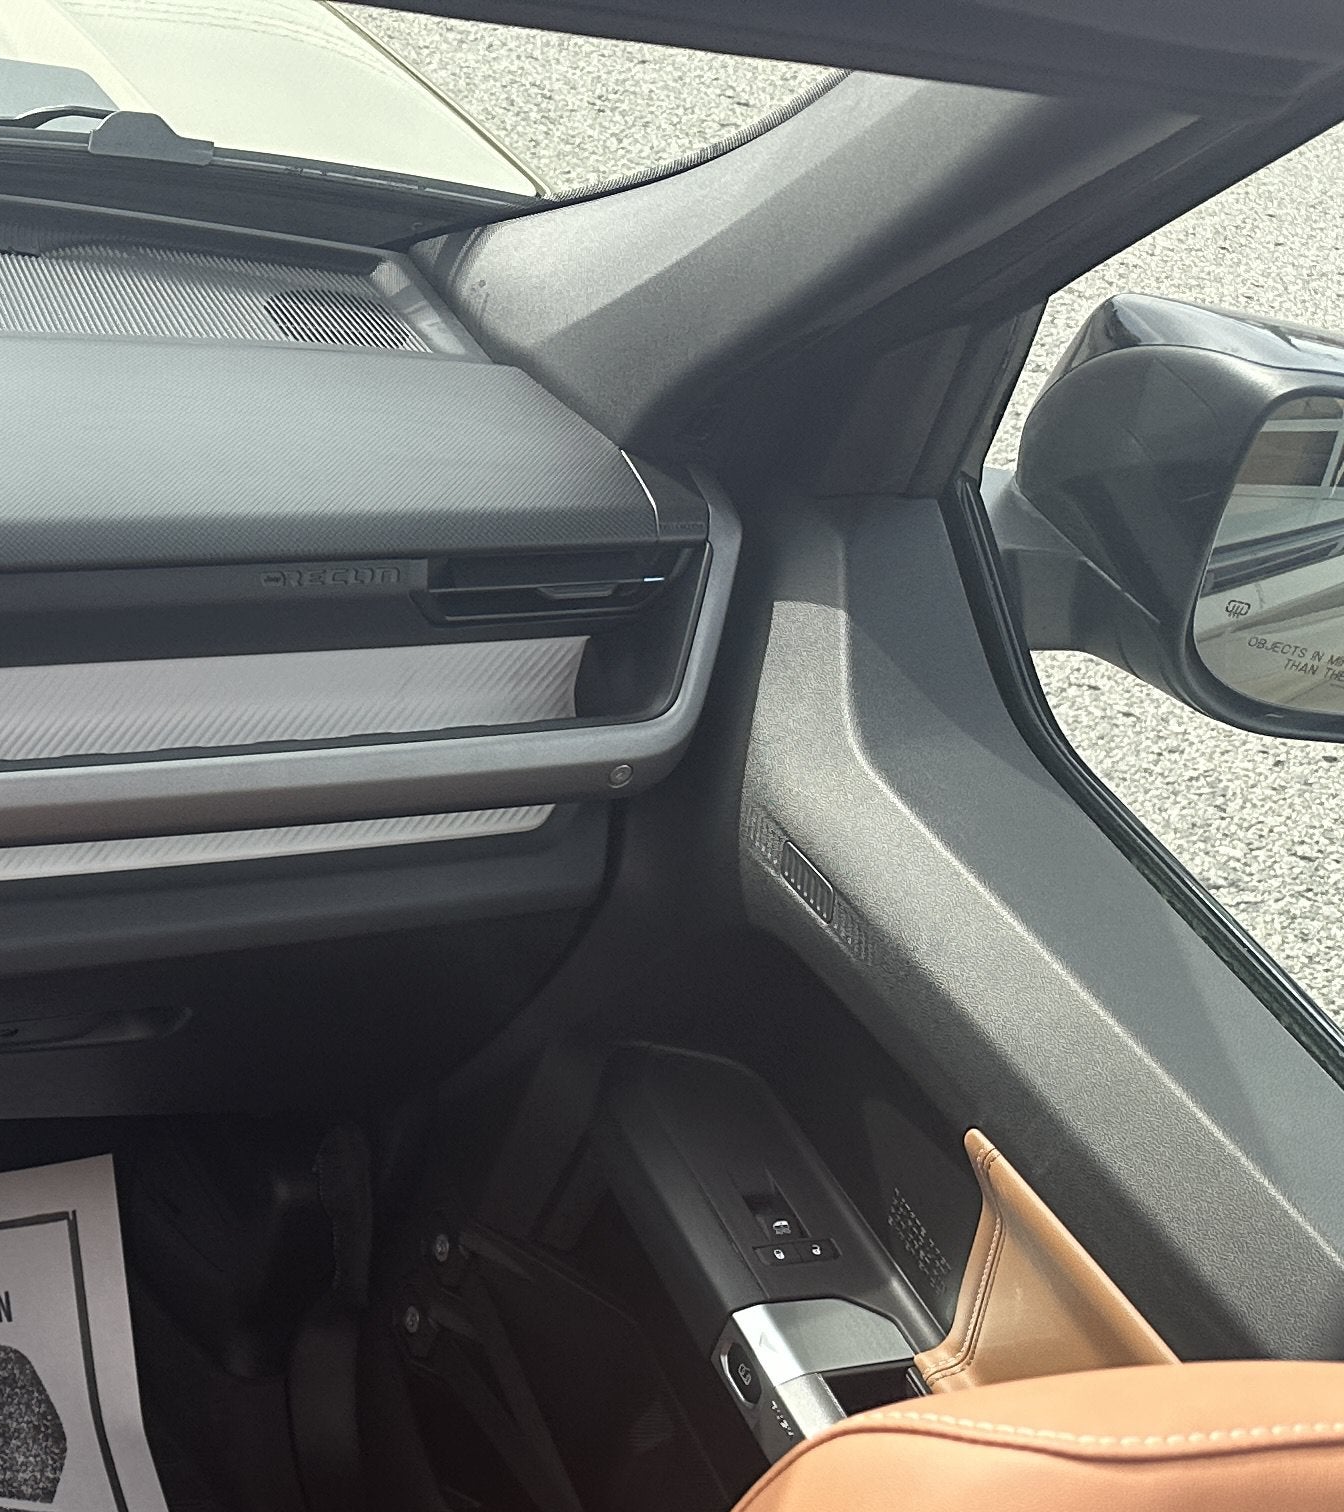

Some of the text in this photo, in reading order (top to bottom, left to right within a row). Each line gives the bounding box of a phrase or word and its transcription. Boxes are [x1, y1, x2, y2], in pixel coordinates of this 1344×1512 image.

[1247, 636, 1325, 663] OBJECTS IN
[1283, 658, 1320, 676] THAN
